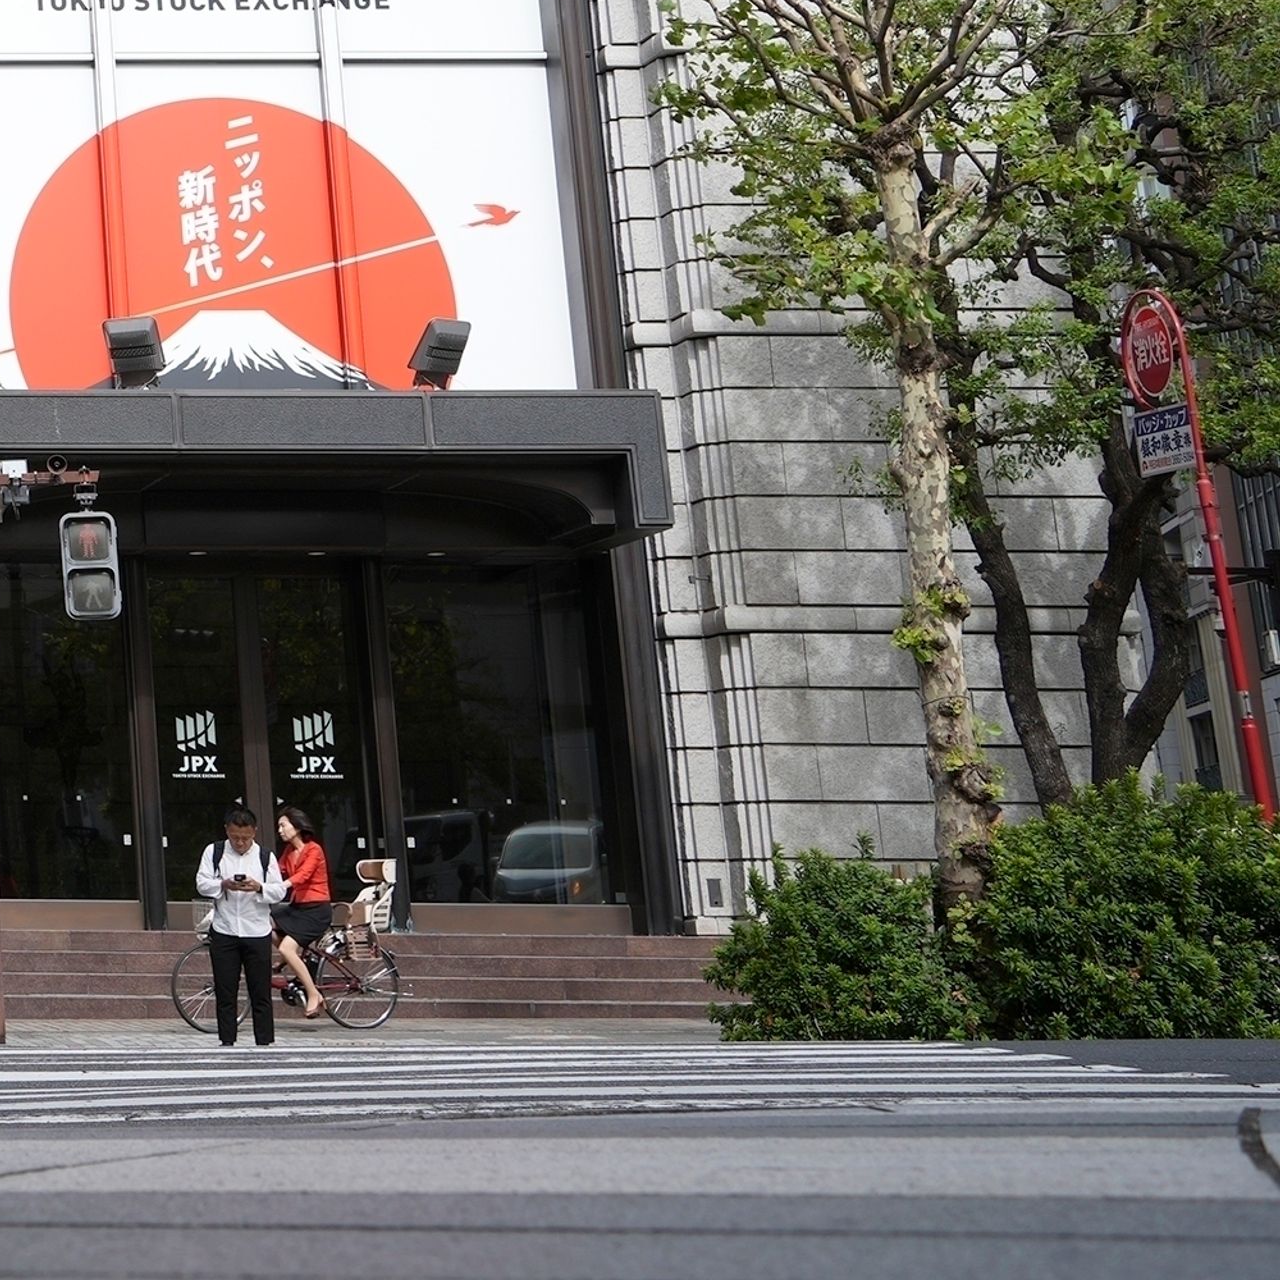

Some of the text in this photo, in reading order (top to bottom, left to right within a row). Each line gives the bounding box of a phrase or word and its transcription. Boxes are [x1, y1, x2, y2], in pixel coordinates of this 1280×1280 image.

[224, 115, 275, 269] ニッポン、
[177, 164, 223, 287] 新時代
[1133, 332, 1170, 372] 消火栓
[179, 756, 218, 772] JPX
[297, 756, 336, 773] JPX
